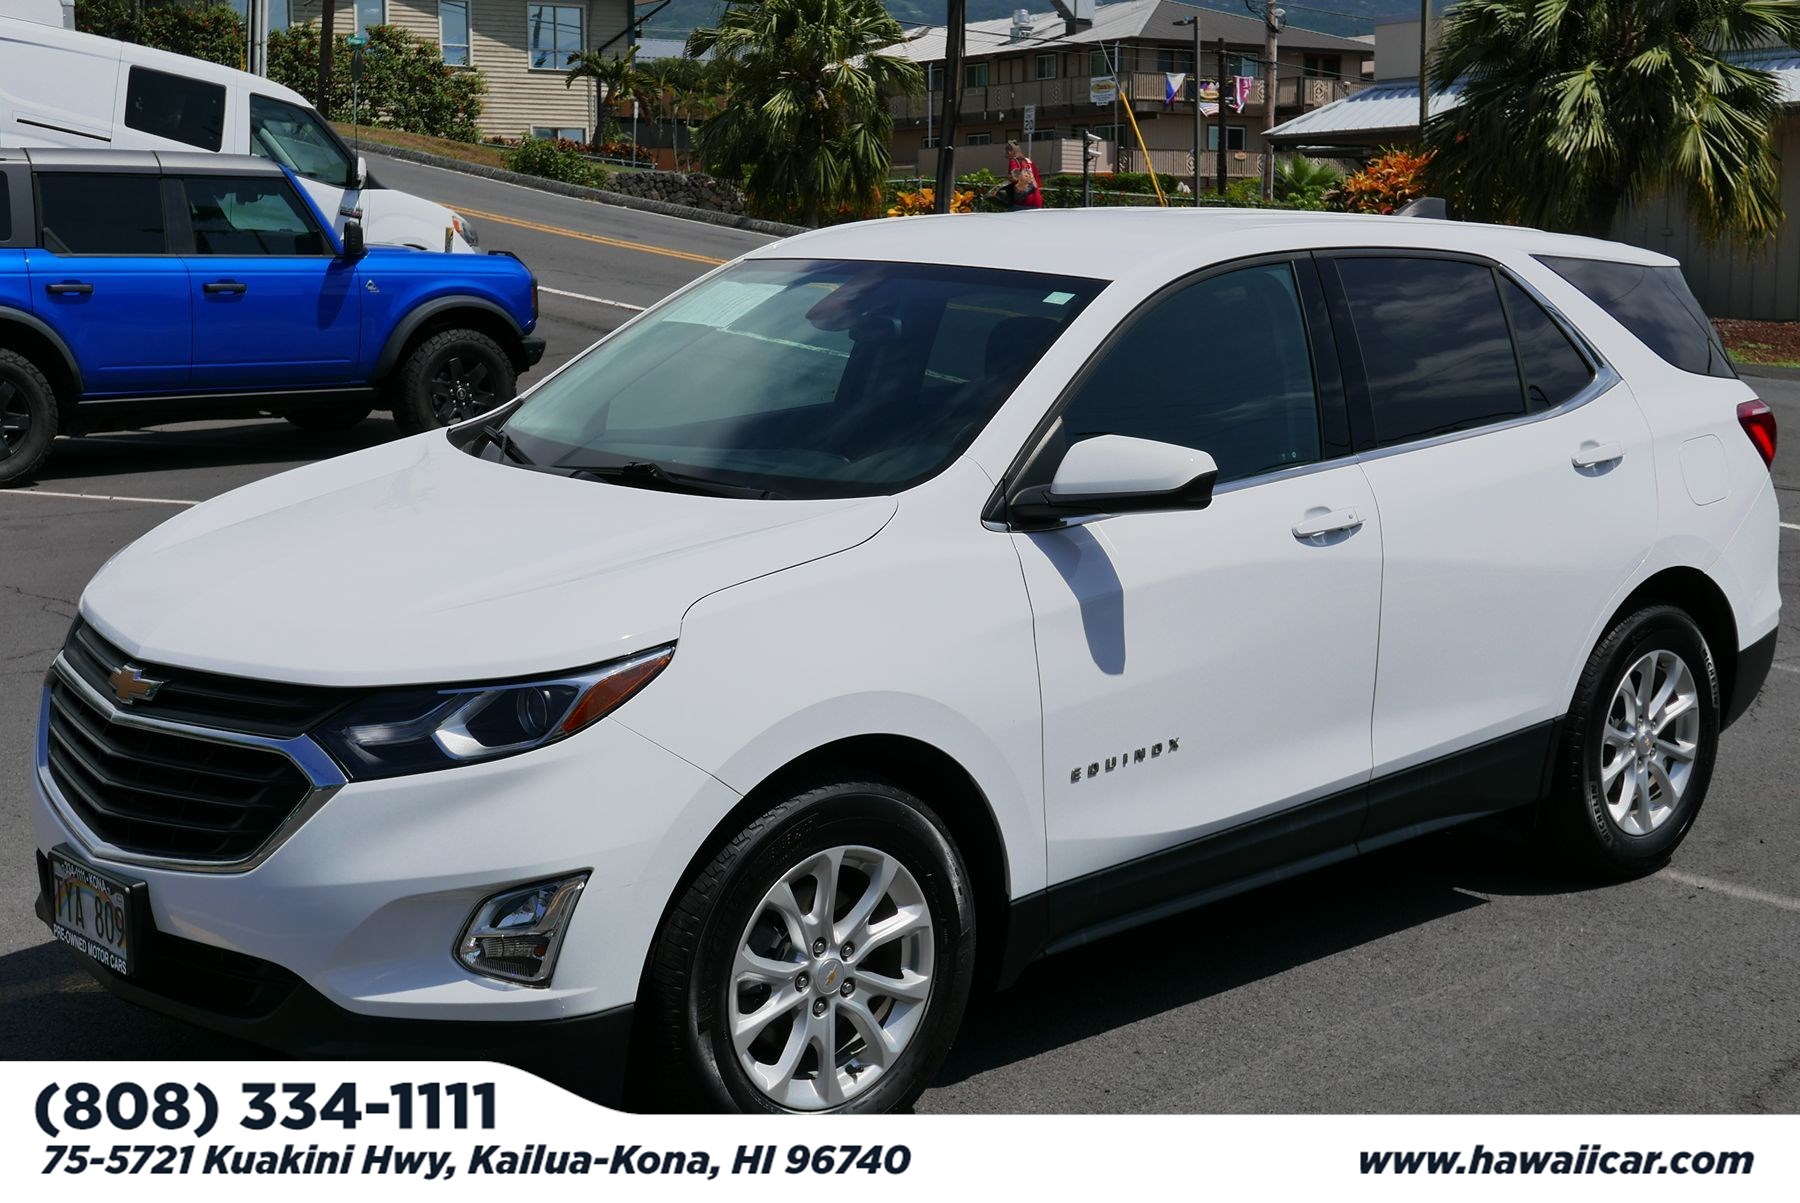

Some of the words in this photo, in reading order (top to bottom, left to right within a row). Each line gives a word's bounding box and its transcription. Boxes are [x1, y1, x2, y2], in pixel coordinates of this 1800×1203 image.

[1070, 737, 1180, 785] EQUINOX
[95, 895, 125, 948] 809
[53, 923, 87, 953] PRE-OWNED
[87, 942, 110, 967] MOTOR
[110, 954, 127, 976] CARS
